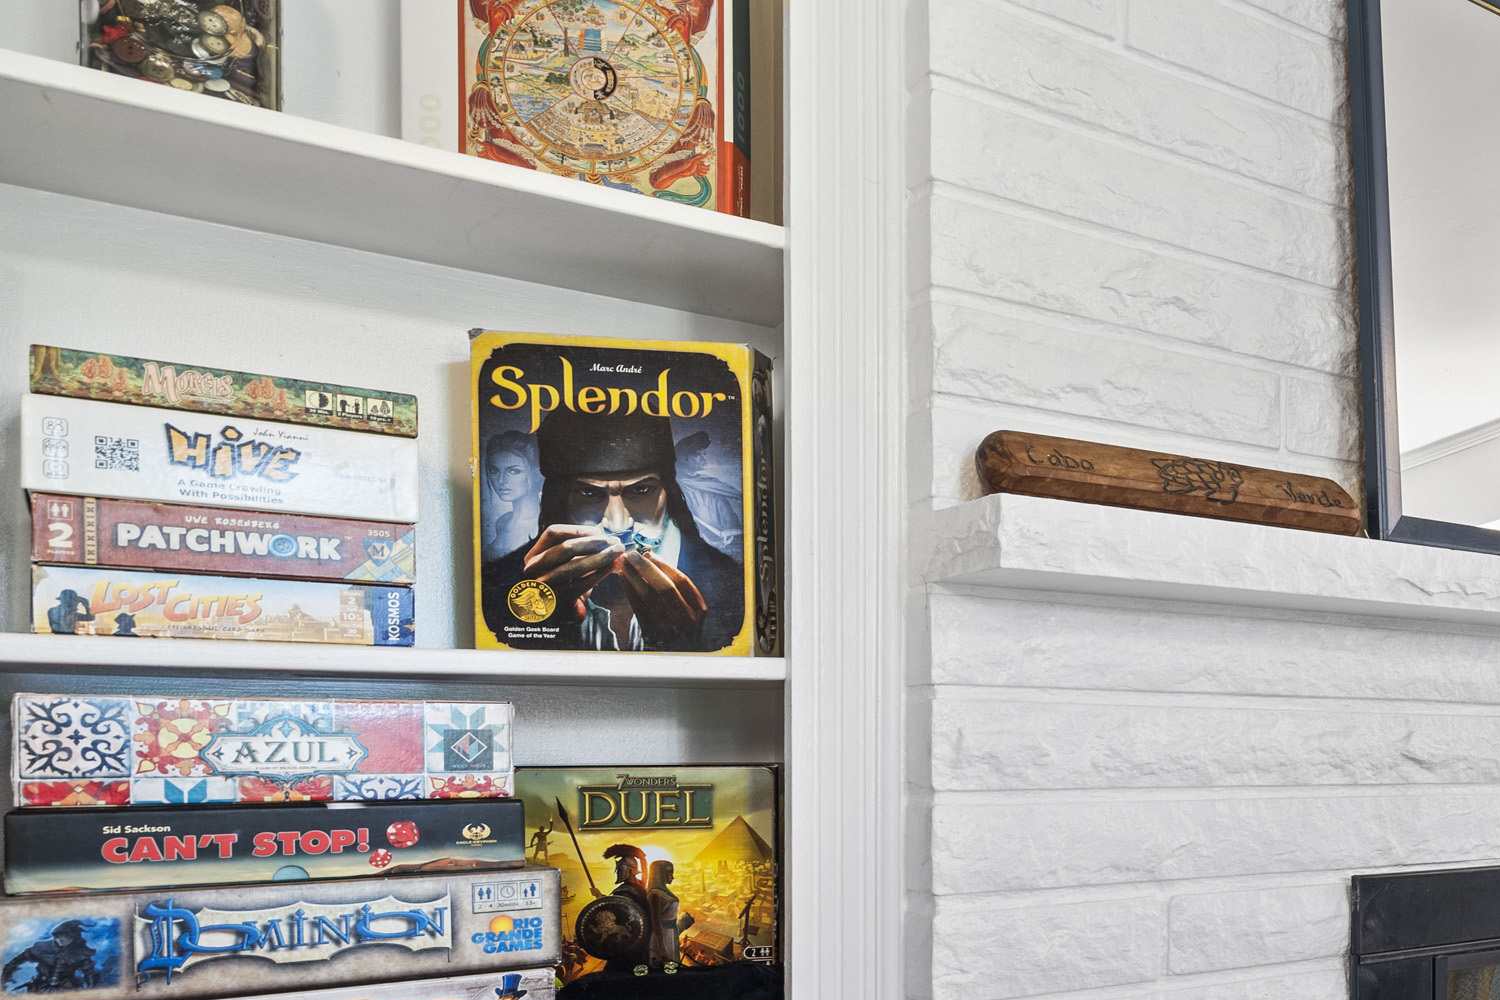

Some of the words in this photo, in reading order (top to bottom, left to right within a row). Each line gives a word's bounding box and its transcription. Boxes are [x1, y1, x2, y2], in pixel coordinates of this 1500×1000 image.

[589, 362, 614, 374] Marc
[616, 363, 642, 375] André
[489, 356, 726, 435] Splendor
[253, 427, 274, 438] John
[278, 431, 309, 441] Yianni
[1025, 445, 1093, 472] Cabo
[1276, 481, 1345, 510] Verde
[189, 480, 225, 489] Game
[229, 484, 281, 495] Crawling
[179, 488, 208, 498] With
[212, 491, 284, 504] Possibilities
[214, 517, 280, 530] ROSENBERG
[757, 450, 774, 582] Splendor
[47, 522, 74, 549] 2
[116, 522, 342, 561] PATCHWORK
[367, 529, 391, 538] 3505
[510, 582, 537, 599] GOLDEN
[539, 584, 553, 600] GEEK
[90, 579, 180, 615] LOST
[162, 592, 263, 625] CITIES
[348, 597, 356, 605] 2
[388, 592, 400, 641] KOSMOS
[232, 741, 339, 764] AZUL
[616, 774, 629, 790] 7
[626, 778, 677, 786] WONDERS
[583, 790, 710, 825] DUEL
[103, 825, 121, 834] Sid
[124, 824, 171, 834] Sackson
[101, 834, 238, 863] CAN'T
[252, 828, 370, 858] STOP!
[513, 917, 542, 930] RIO
[471, 928, 542, 944] GRANDE
[483, 940, 543, 954] GAMES
[752, 948, 756, 957] 2
